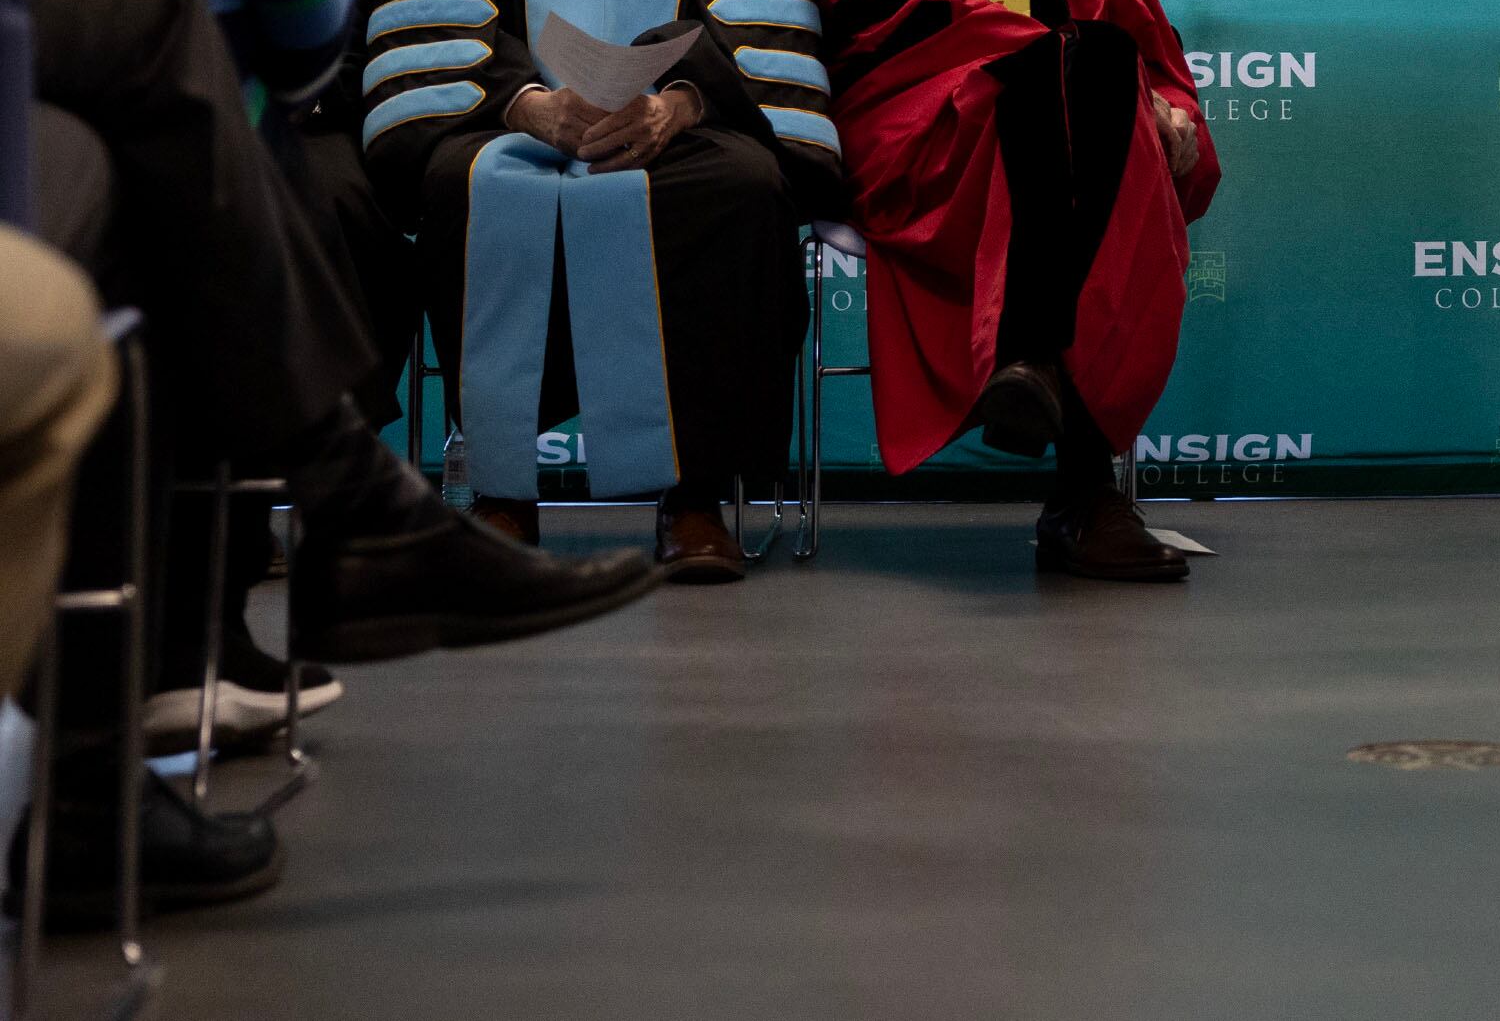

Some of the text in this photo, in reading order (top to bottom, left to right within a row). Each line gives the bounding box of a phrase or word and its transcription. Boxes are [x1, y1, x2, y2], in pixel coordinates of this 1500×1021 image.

[1184, 51, 1316, 88] SIGN
[1204, 99, 1293, 121] LEGE
[1137, 433, 1315, 463] NSIGN
[1142, 463, 1285, 486] OLLEGE
